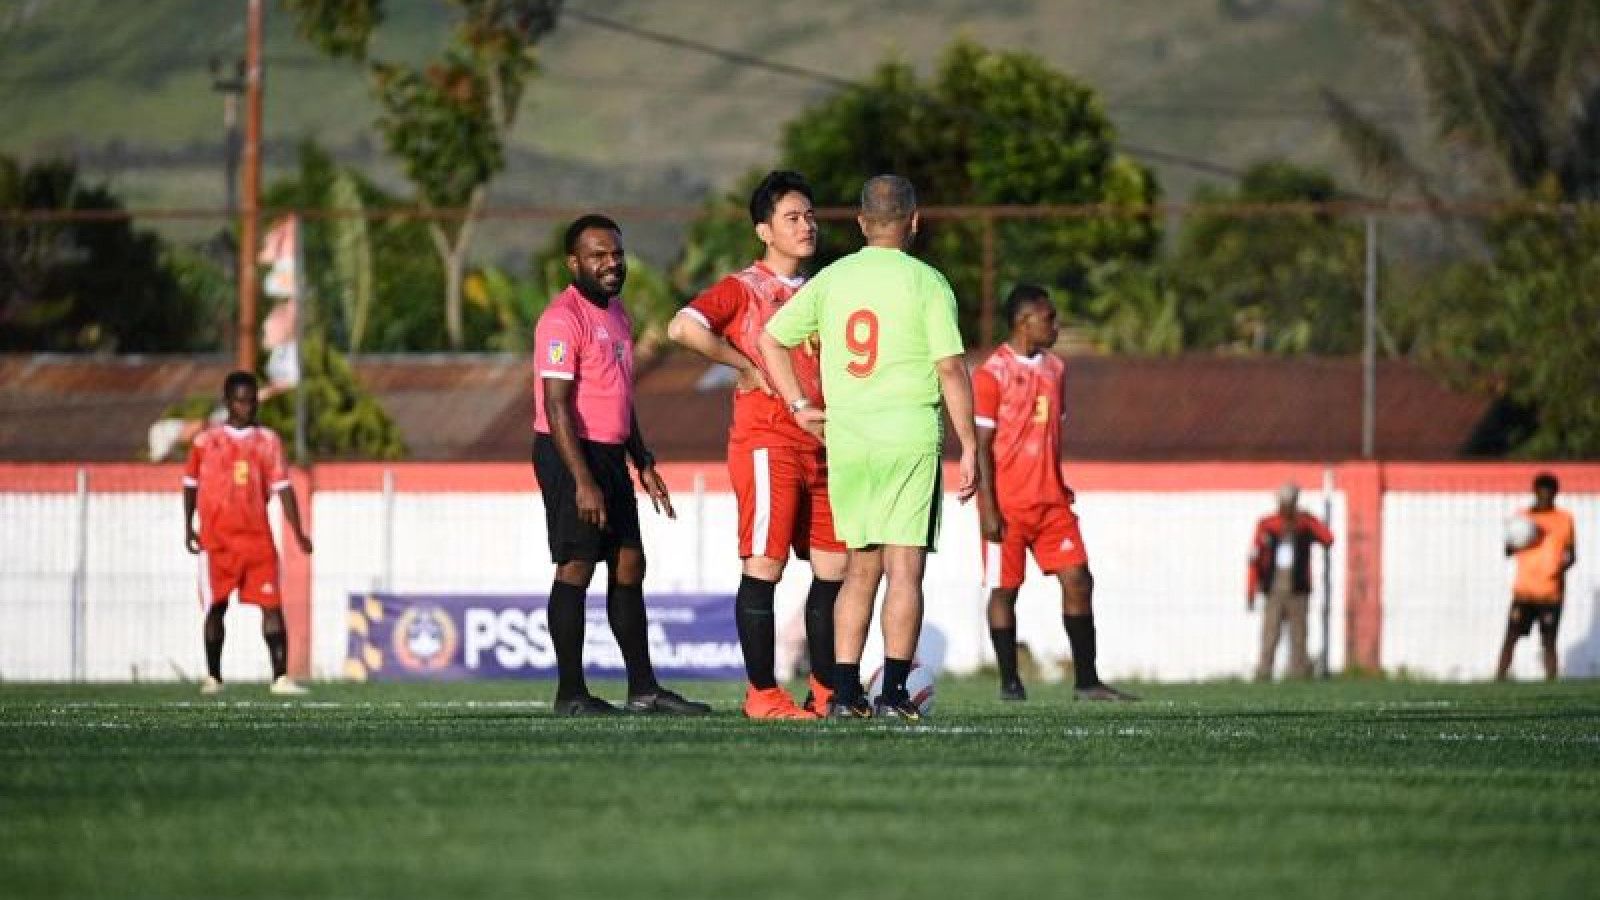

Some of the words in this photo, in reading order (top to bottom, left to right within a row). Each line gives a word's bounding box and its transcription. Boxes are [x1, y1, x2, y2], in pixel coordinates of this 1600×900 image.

[846, 308, 879, 378] 9
[1034, 395, 1049, 423] 3
[233, 460, 249, 485] 2
